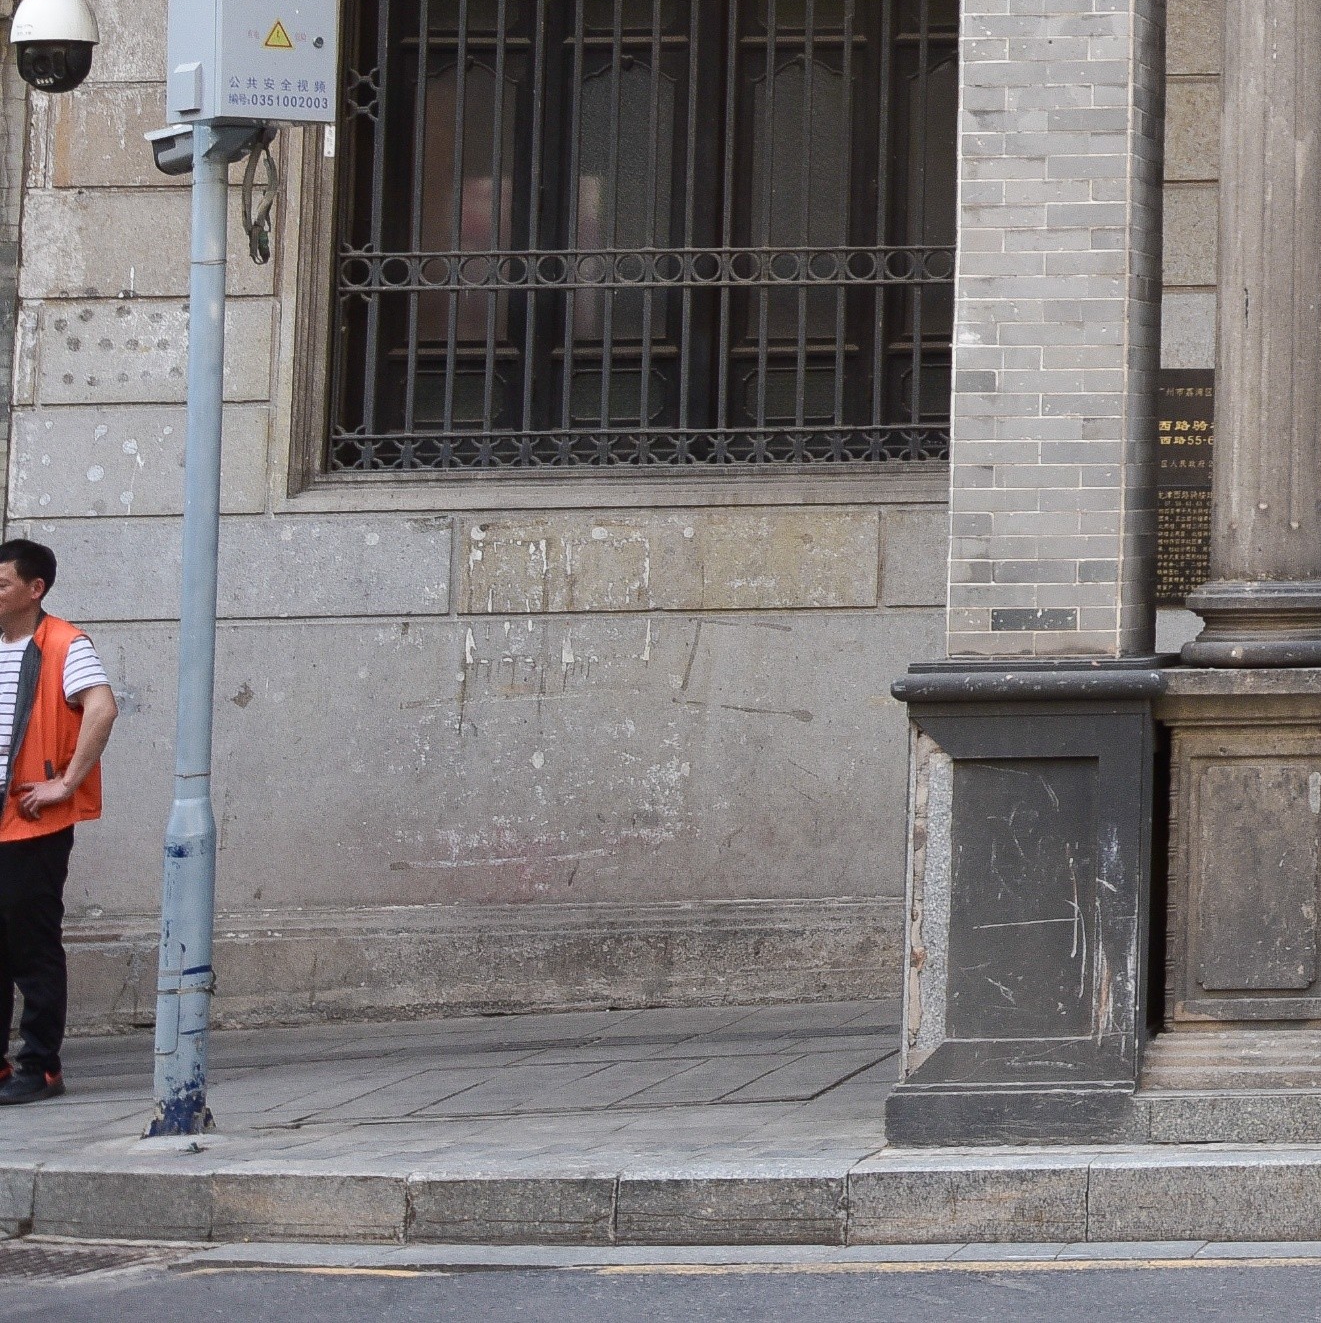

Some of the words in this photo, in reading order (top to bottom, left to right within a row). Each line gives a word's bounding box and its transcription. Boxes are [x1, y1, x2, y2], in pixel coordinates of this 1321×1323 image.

[229, 76, 327, 94] 公共安全视频
